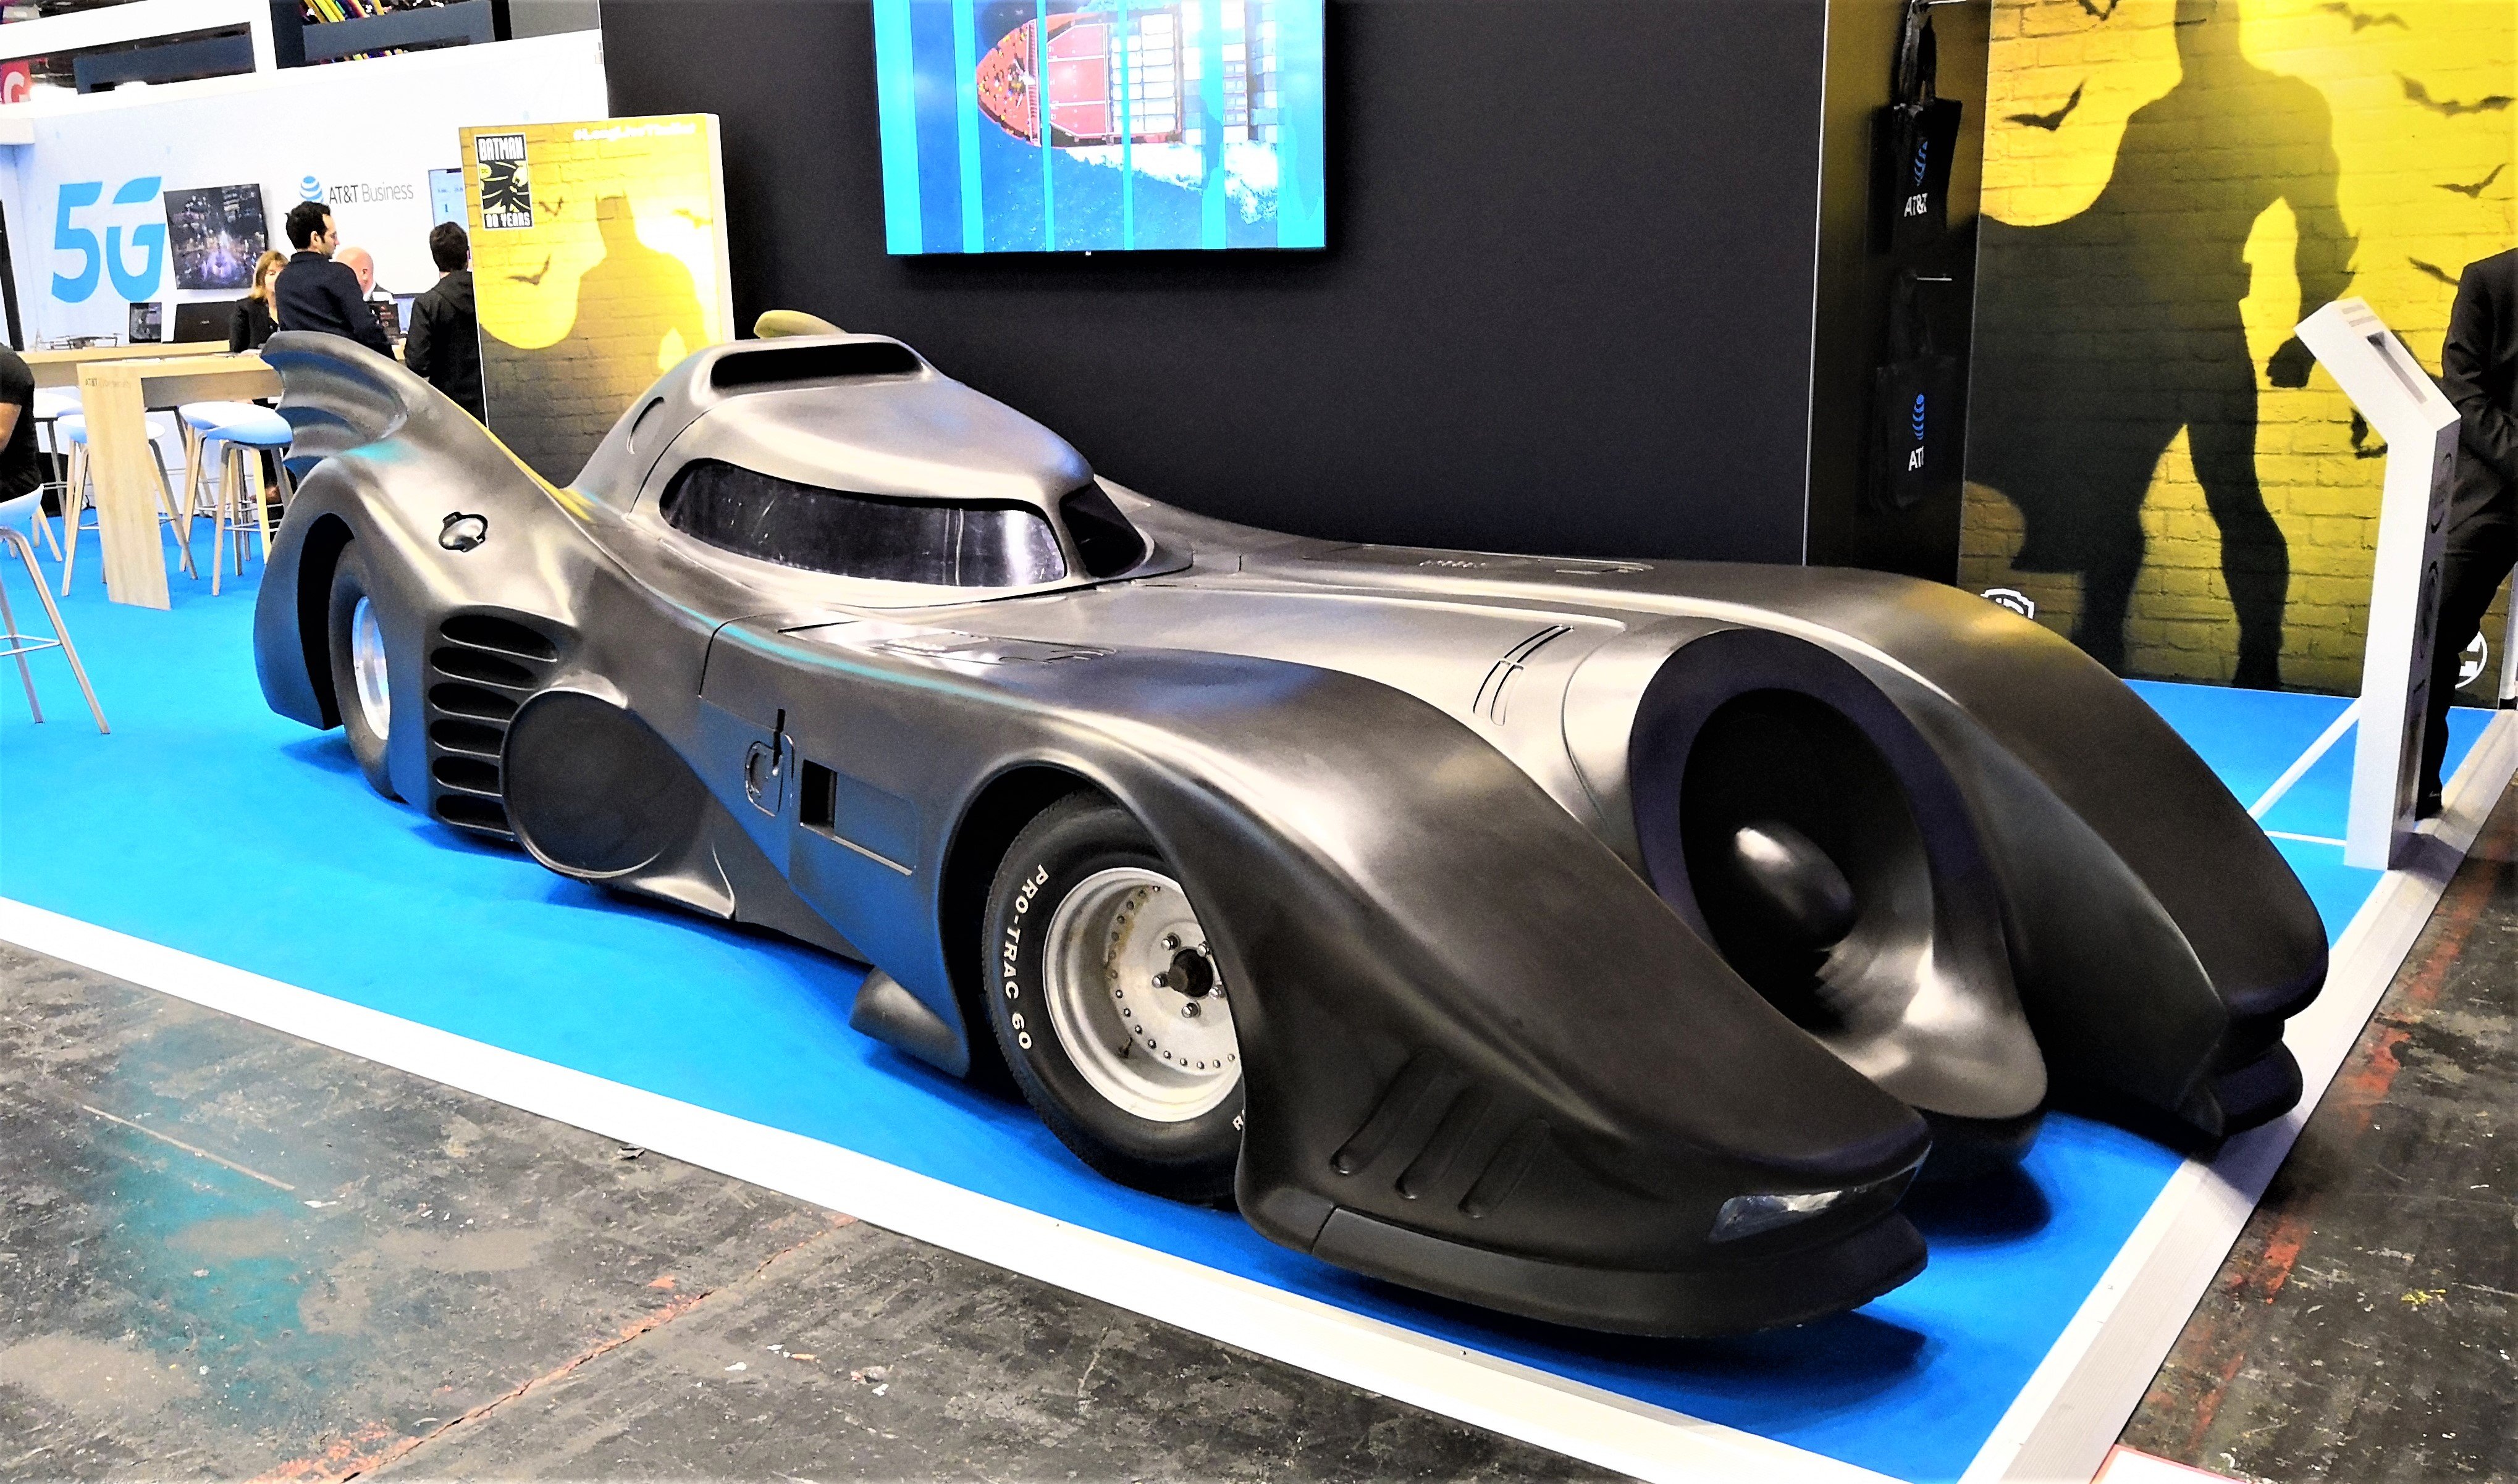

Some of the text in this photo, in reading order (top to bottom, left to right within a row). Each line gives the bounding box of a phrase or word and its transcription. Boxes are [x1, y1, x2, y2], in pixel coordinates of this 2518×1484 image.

[478, 136, 524, 161] BATMAN
[329, 182, 414, 204] AT&T Business
[500, 212, 531, 227] YEARS
[51, 176, 166, 303] 5G
[1004, 864, 1050, 1050] PRO-TRAC 60
